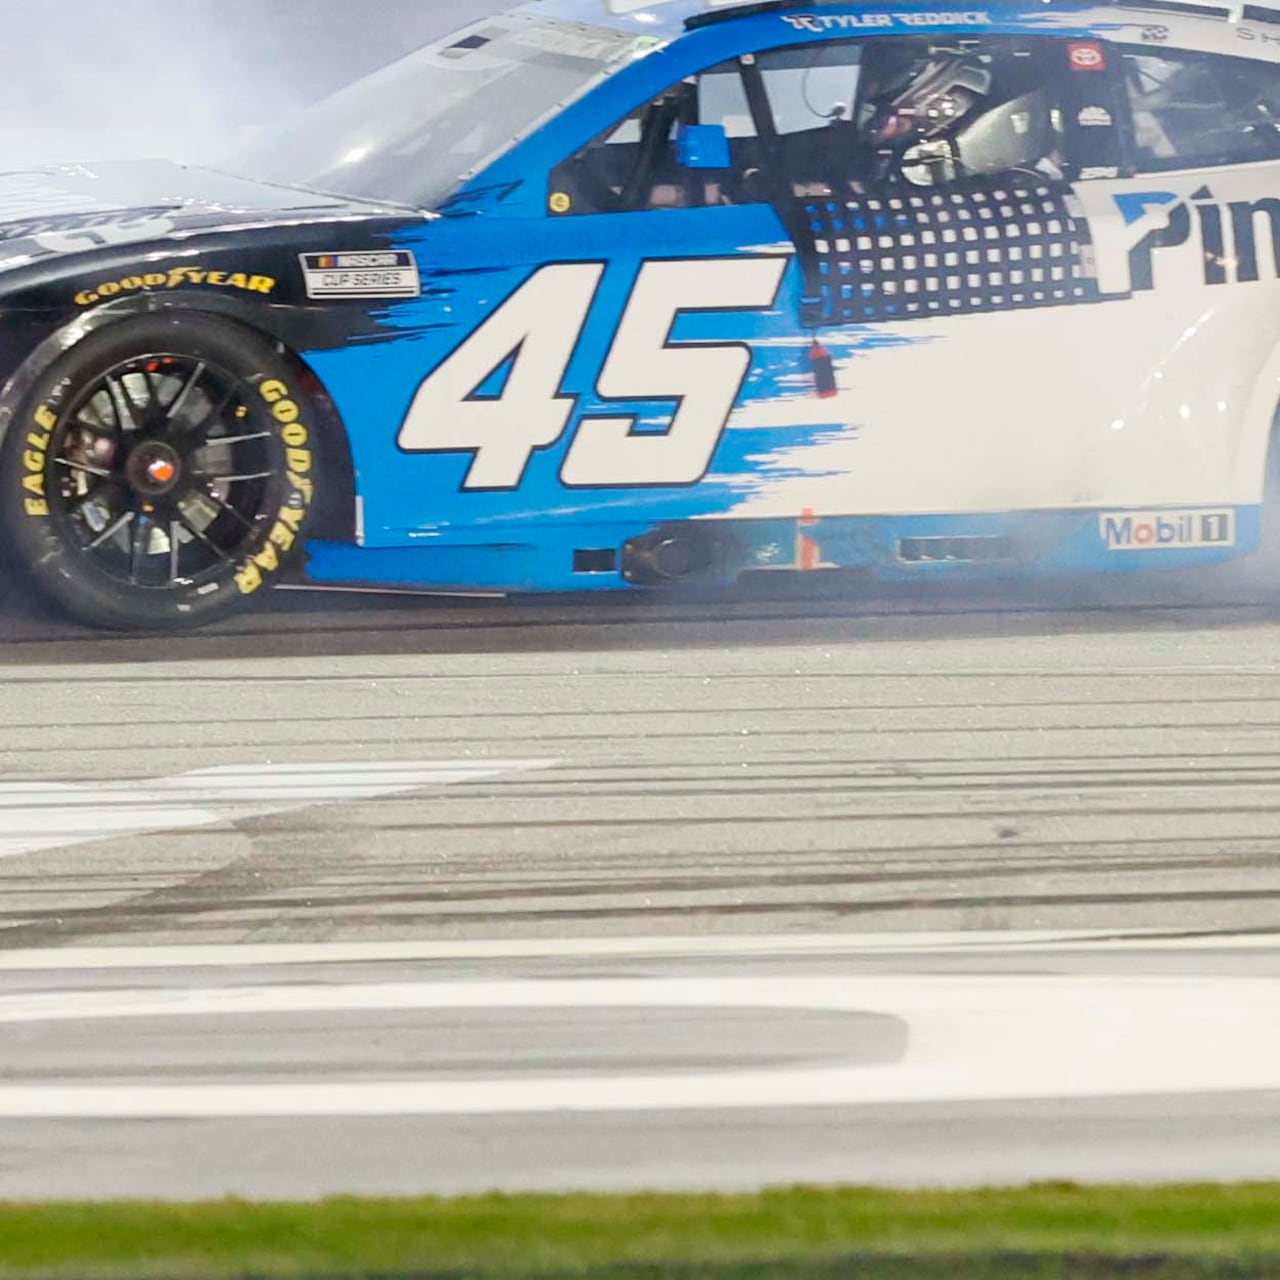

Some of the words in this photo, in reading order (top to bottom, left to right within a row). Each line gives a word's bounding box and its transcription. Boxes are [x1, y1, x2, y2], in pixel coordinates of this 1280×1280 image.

[818, 14, 893, 28] TYLER
[73, 266, 276, 305] GOODYEAR
[321, 272, 349, 287] CUP
[352, 271, 402, 287] SERIES
[396, 253, 792, 493] 45
[21, 404, 58, 517] EAGLE
[233, 379, 312, 595] GOODYEAR
[1105, 514, 1193, 545] Mobil
